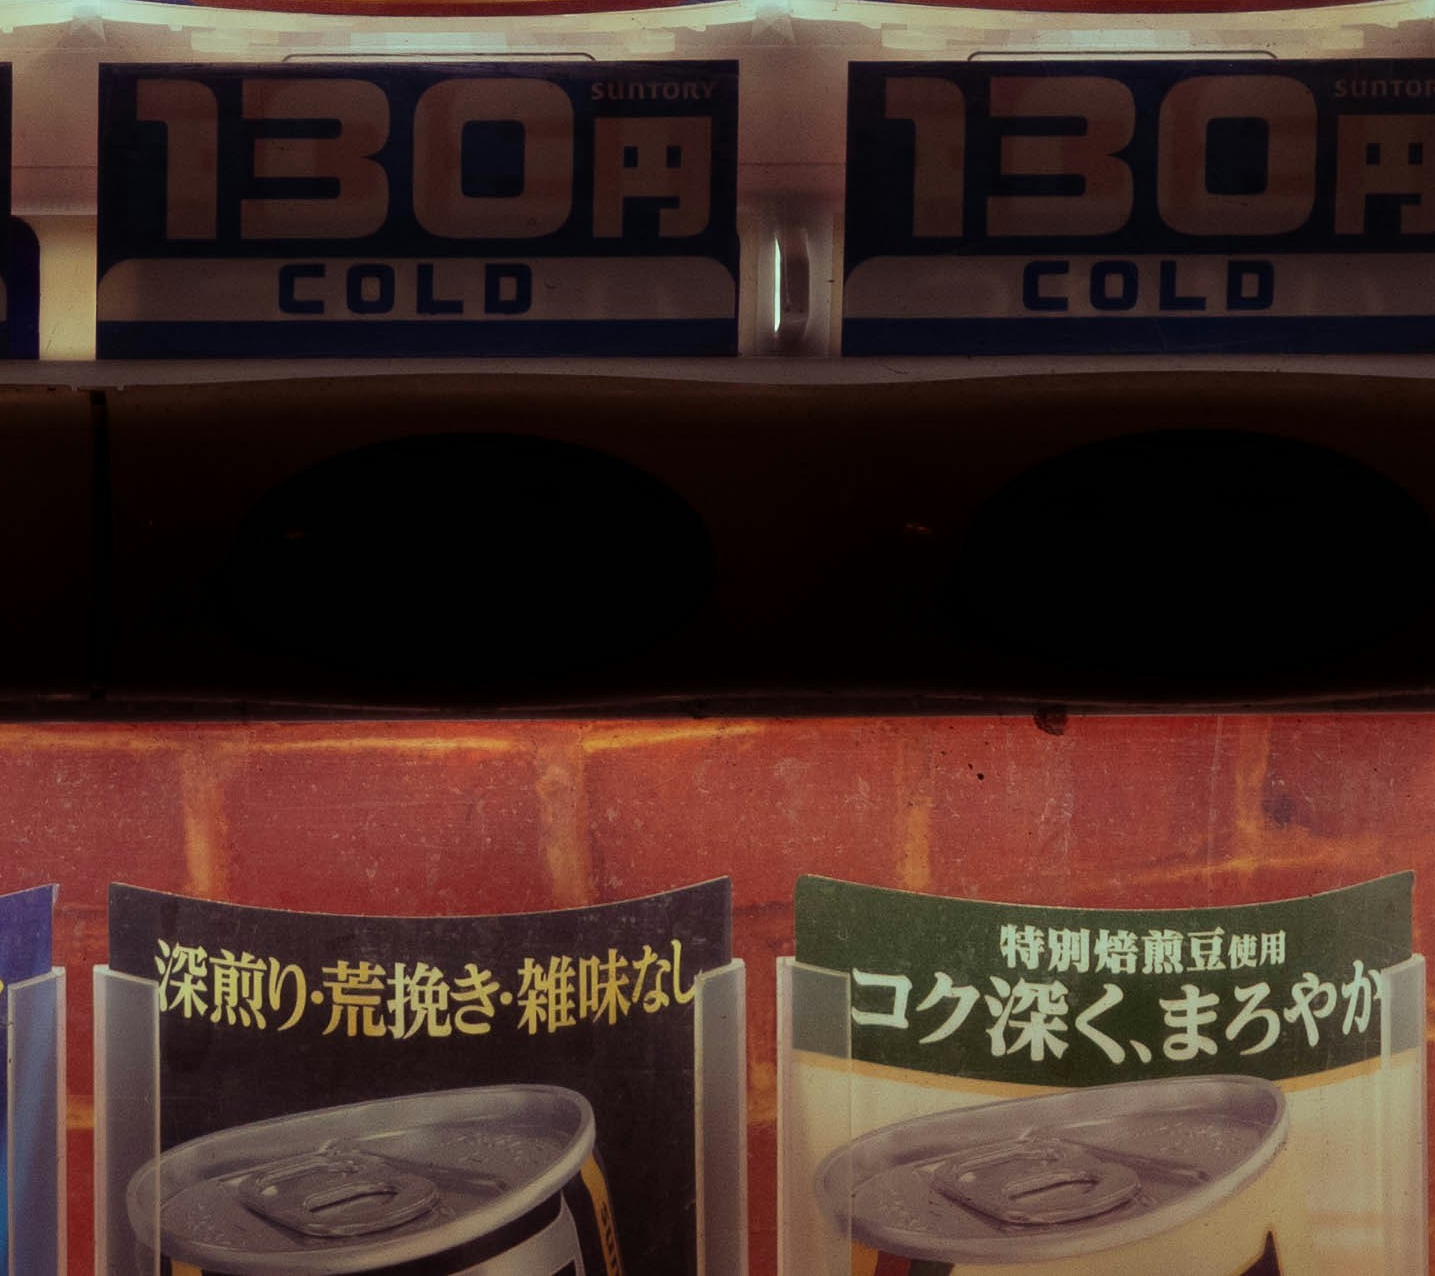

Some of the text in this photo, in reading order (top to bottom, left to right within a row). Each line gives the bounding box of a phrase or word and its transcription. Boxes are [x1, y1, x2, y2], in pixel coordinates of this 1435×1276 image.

[278, 263, 533, 316] COLD
[1022, 260, 1275, 313] COLD
[1000, 923, 1287, 976] 特別焙煎豆使用
[851, 959, 1385, 1065] コク深く、まろやか
